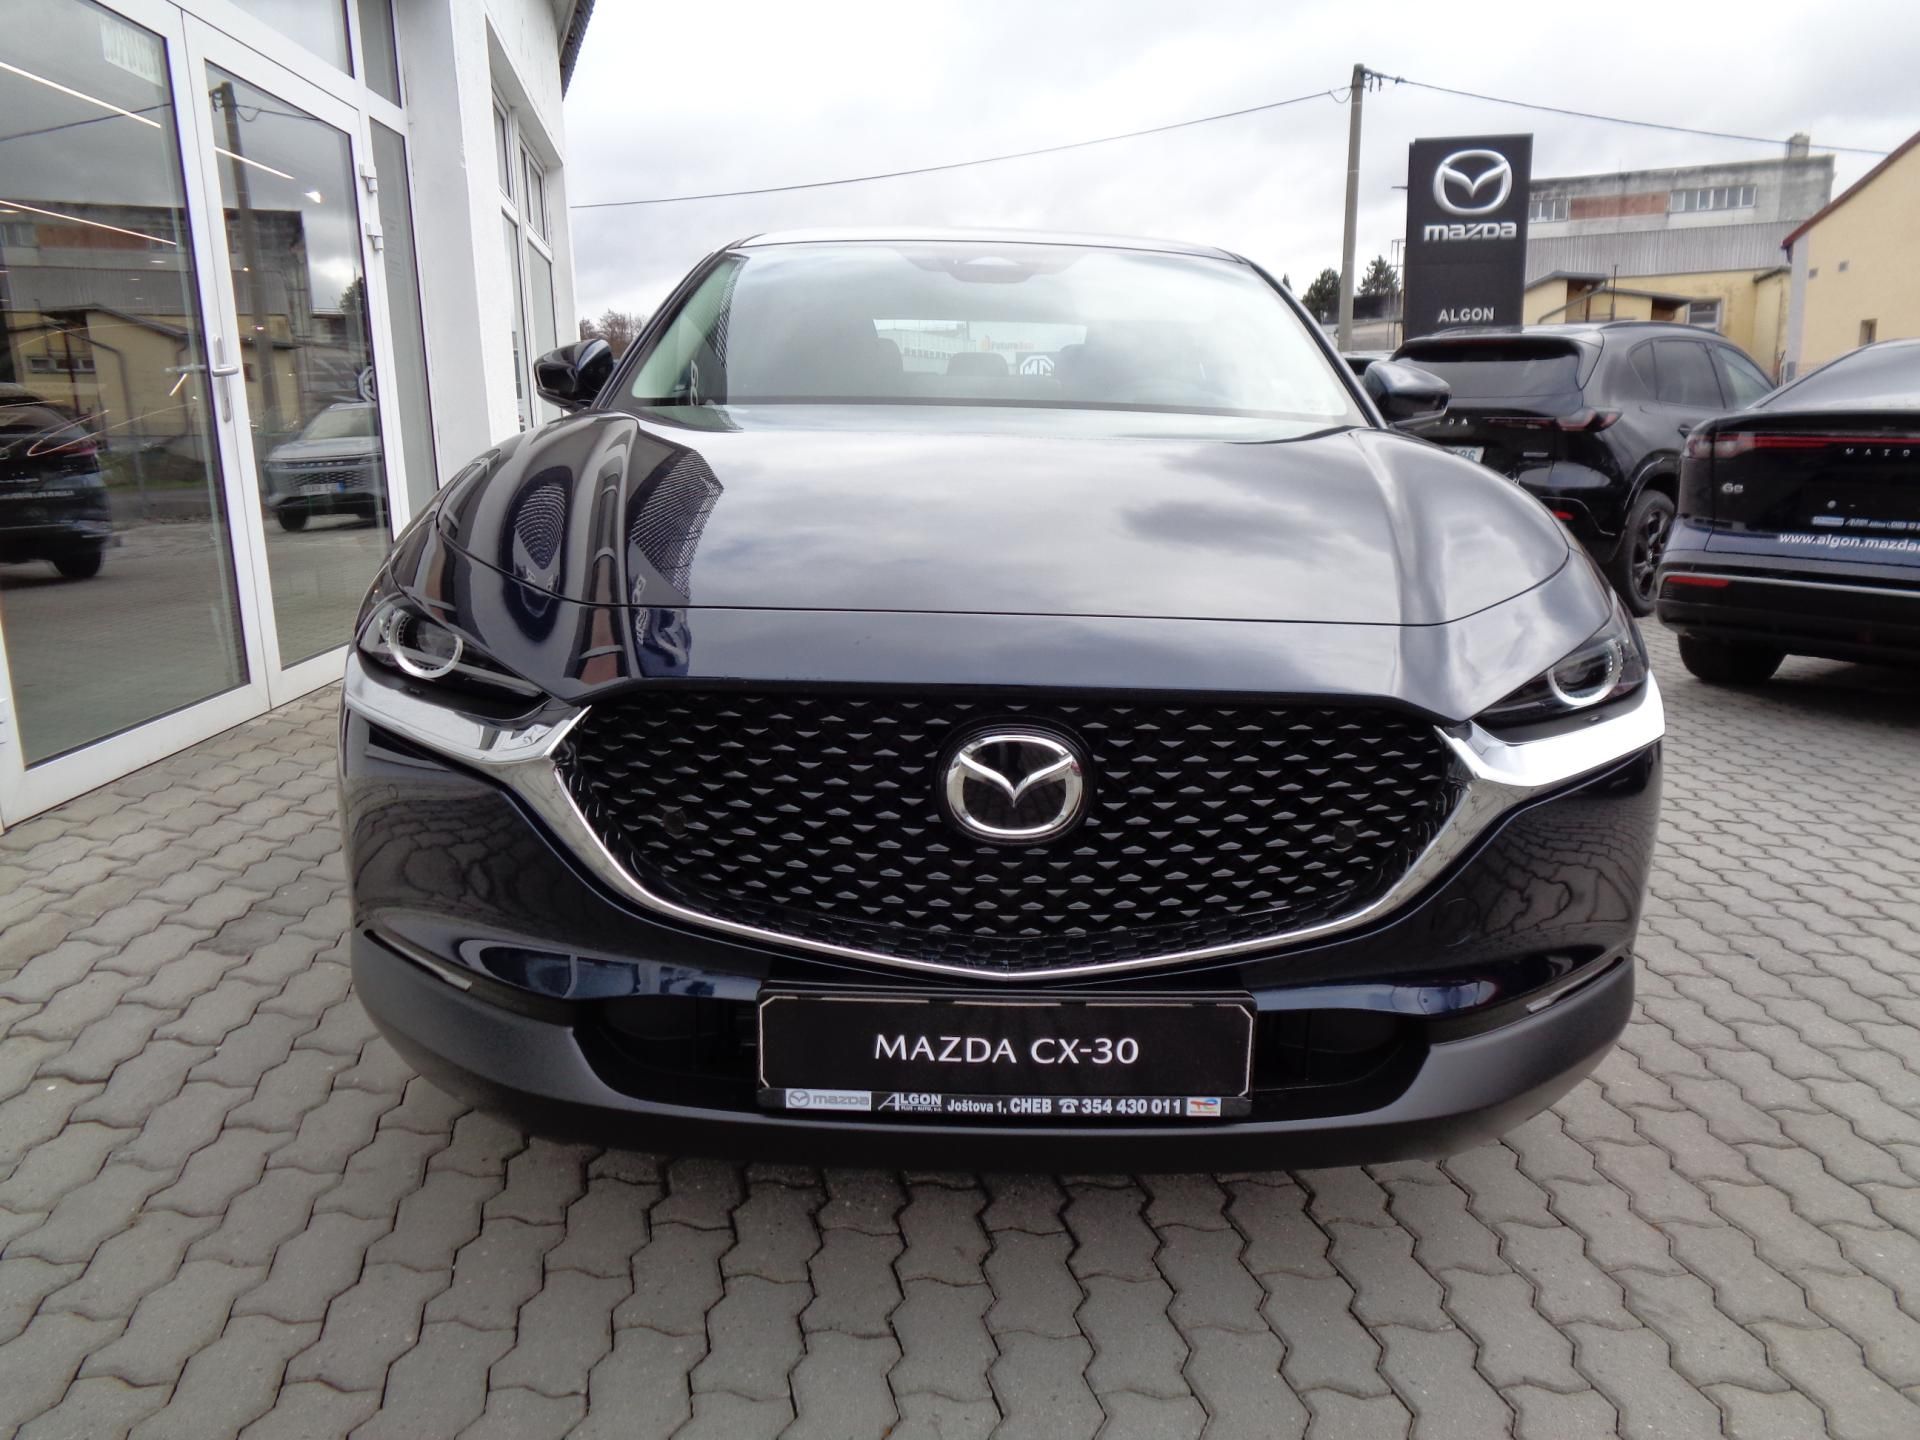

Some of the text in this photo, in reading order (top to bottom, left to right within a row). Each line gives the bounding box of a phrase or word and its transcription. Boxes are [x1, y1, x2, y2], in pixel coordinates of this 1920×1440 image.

[1438, 307, 1495, 322] ALGON
[875, 1034, 1139, 1064] MAZDA CX-30
[877, 1092, 942, 1111] ALGON
[948, 1099, 994, 1113] Joštova
[997, 1100, 1007, 1114] 1,
[1010, 1098, 1052, 1113] CHEB
[1081, 1099, 1113, 1114] 354
[1116, 1100, 1148, 1114] 430
[1151, 1100, 1181, 1114] 011
